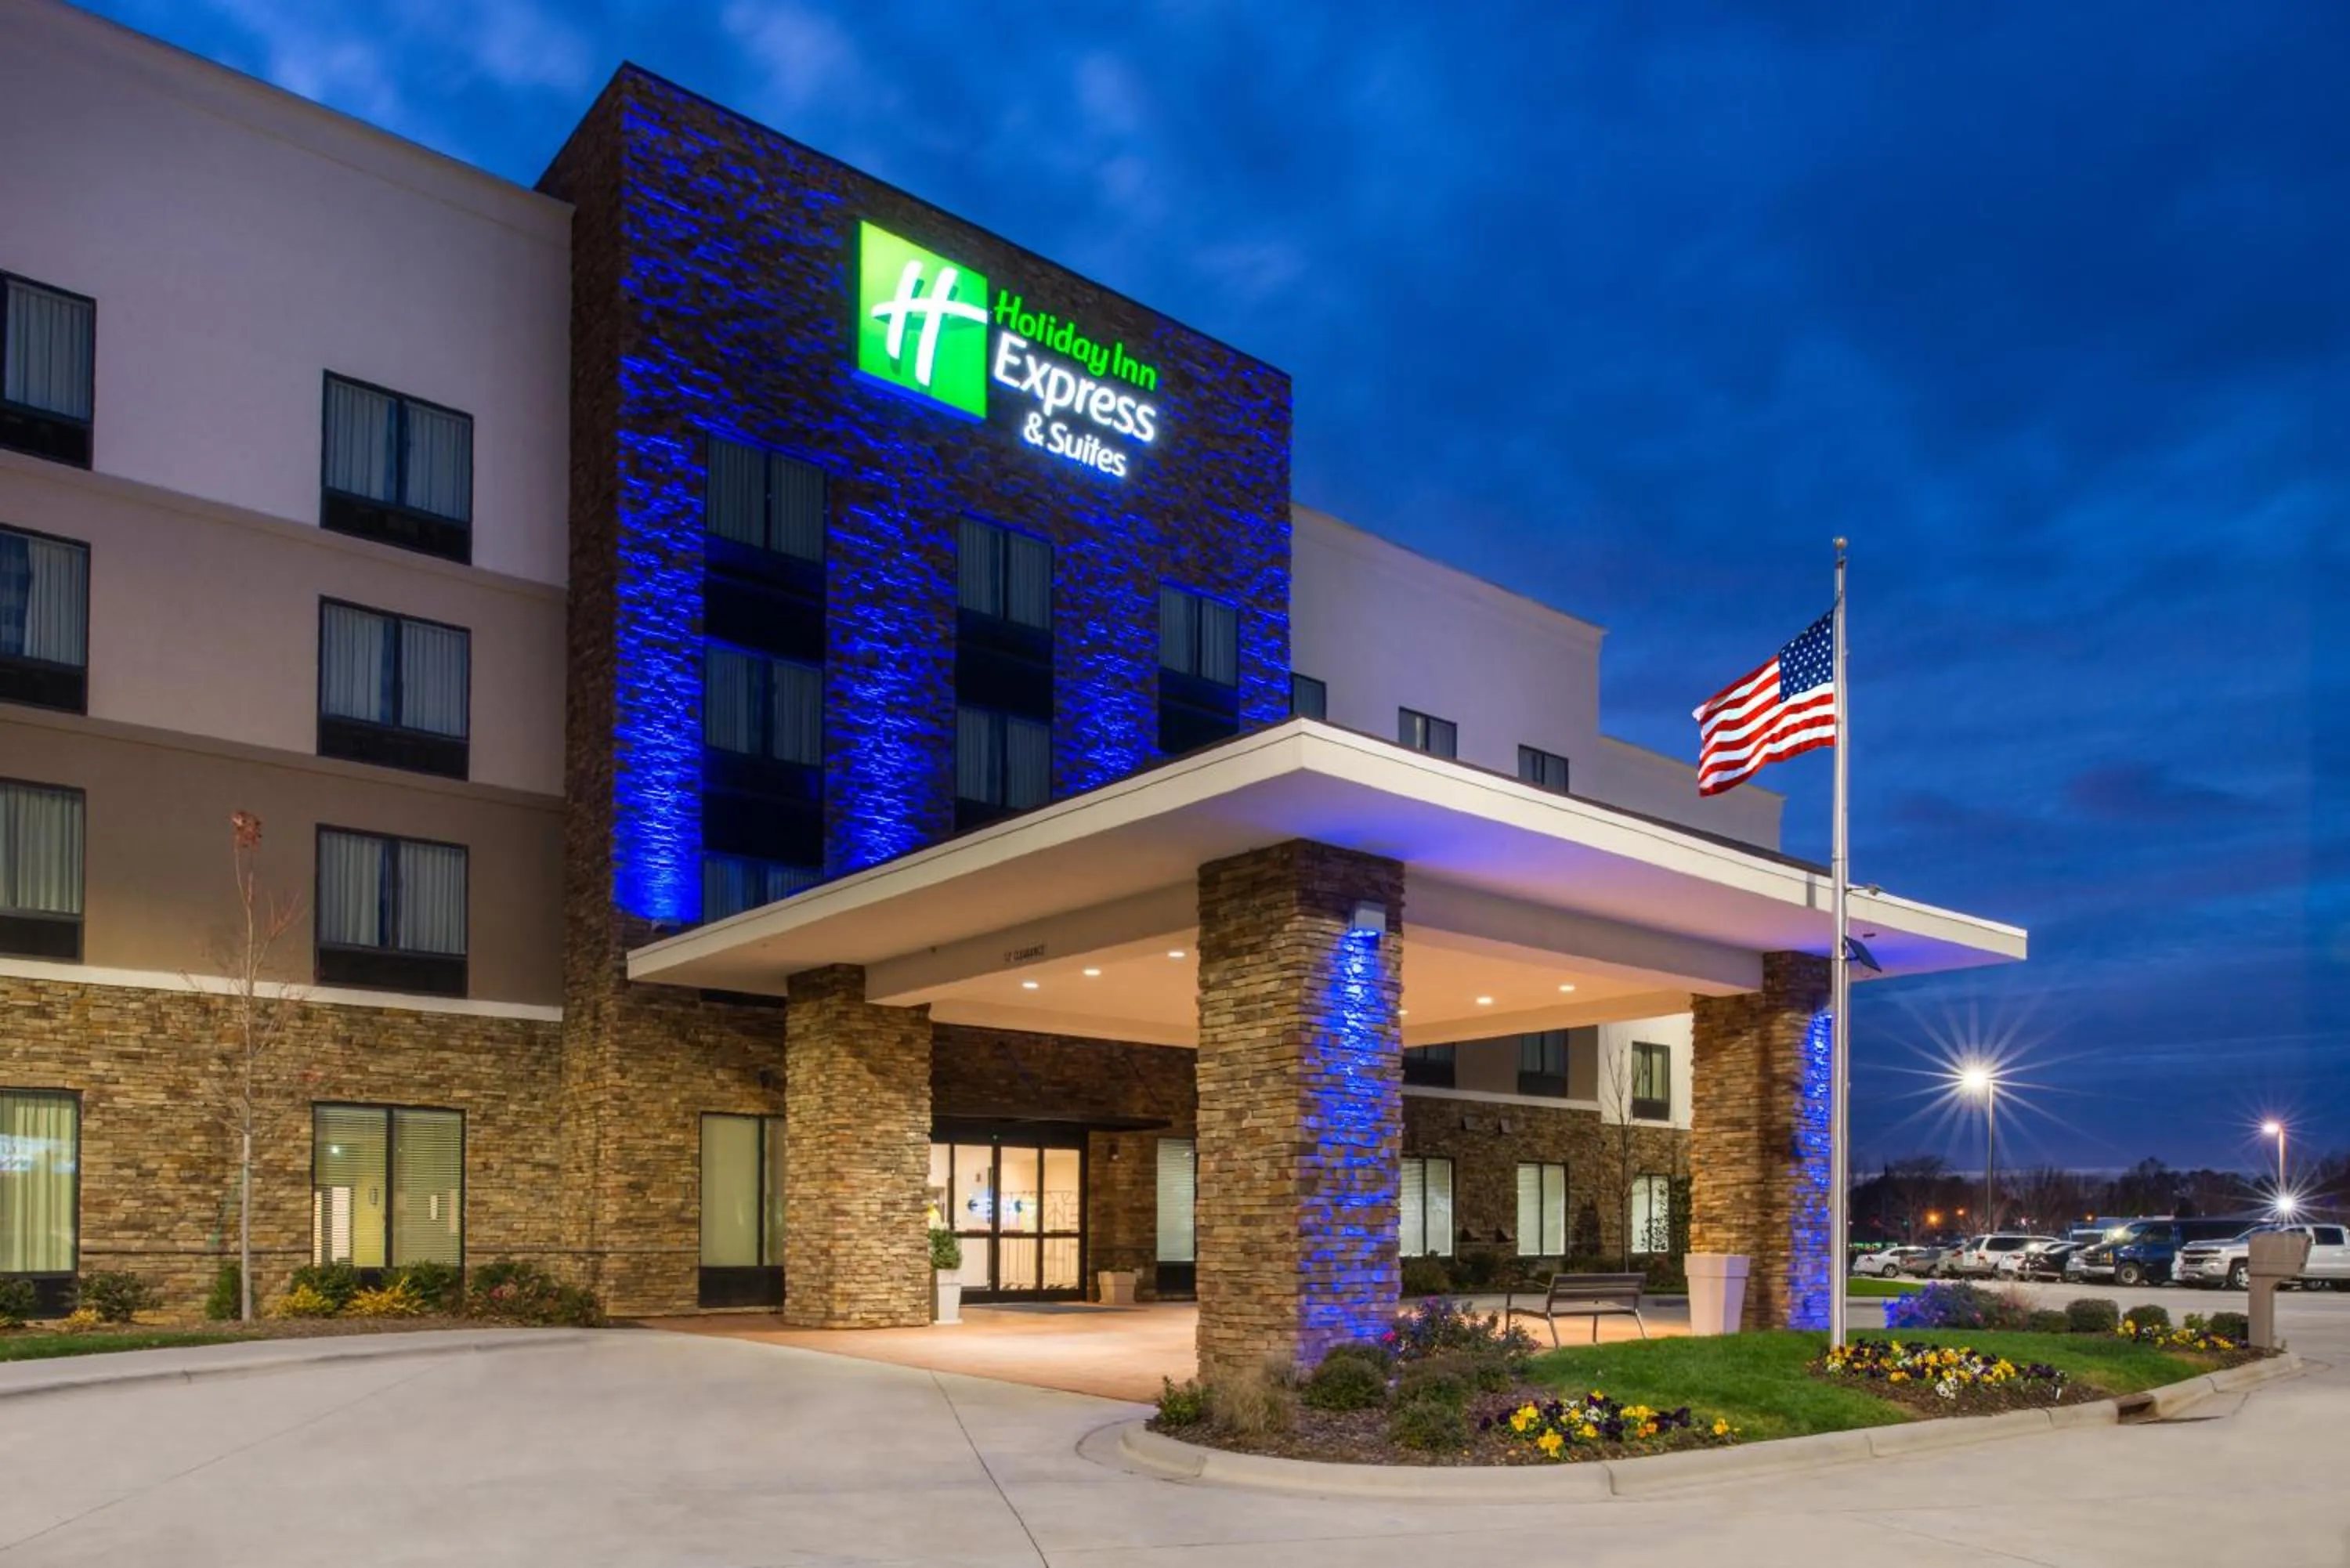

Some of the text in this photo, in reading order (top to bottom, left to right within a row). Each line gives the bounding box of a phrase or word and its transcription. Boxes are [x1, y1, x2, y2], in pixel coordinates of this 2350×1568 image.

[993, 331, 1157, 443] Express
[995, 290, 1157, 391] Holiday Inn
[1024, 412, 1126, 478] & Suites
